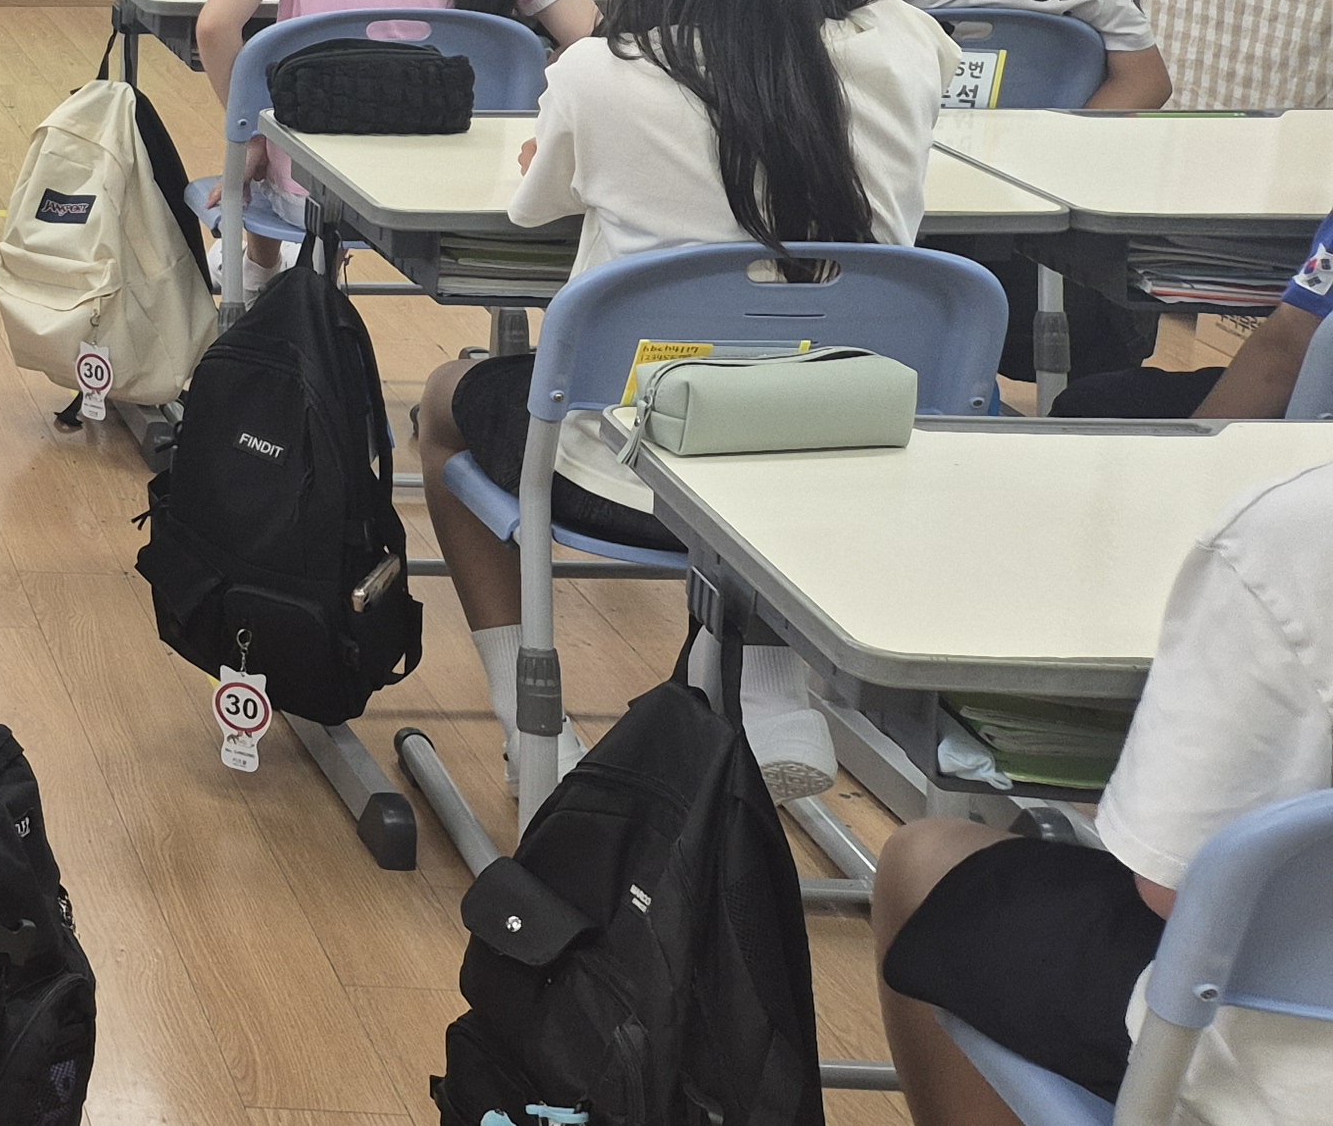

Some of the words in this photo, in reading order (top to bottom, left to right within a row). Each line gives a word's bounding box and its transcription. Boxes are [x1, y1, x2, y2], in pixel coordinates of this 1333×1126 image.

[83, 362, 104, 382] 30
[238, 432, 285, 460] FINDIT
[225, 693, 258, 720] 30
